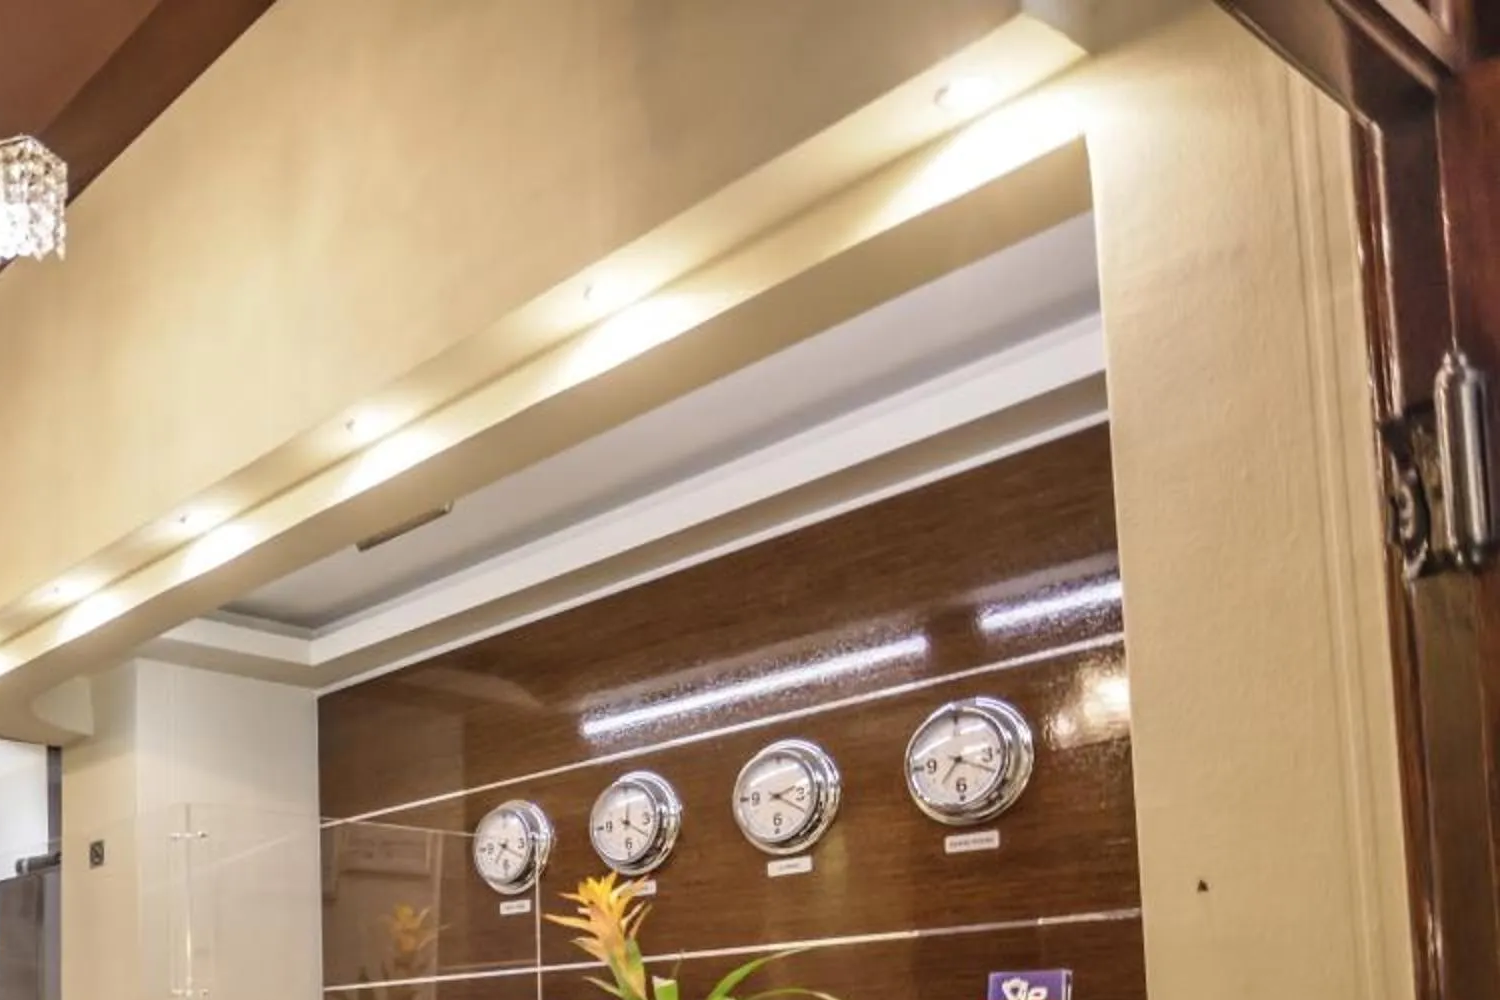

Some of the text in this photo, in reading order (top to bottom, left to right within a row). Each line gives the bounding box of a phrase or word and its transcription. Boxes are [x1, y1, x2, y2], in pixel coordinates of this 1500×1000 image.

[981, 746, 993, 763] 3
[926, 758, 938, 774] 9
[955, 777, 968, 794] 6
[751, 791, 761, 806] 9
[795, 787, 805, 801] 3
[773, 812, 783, 827] 6
